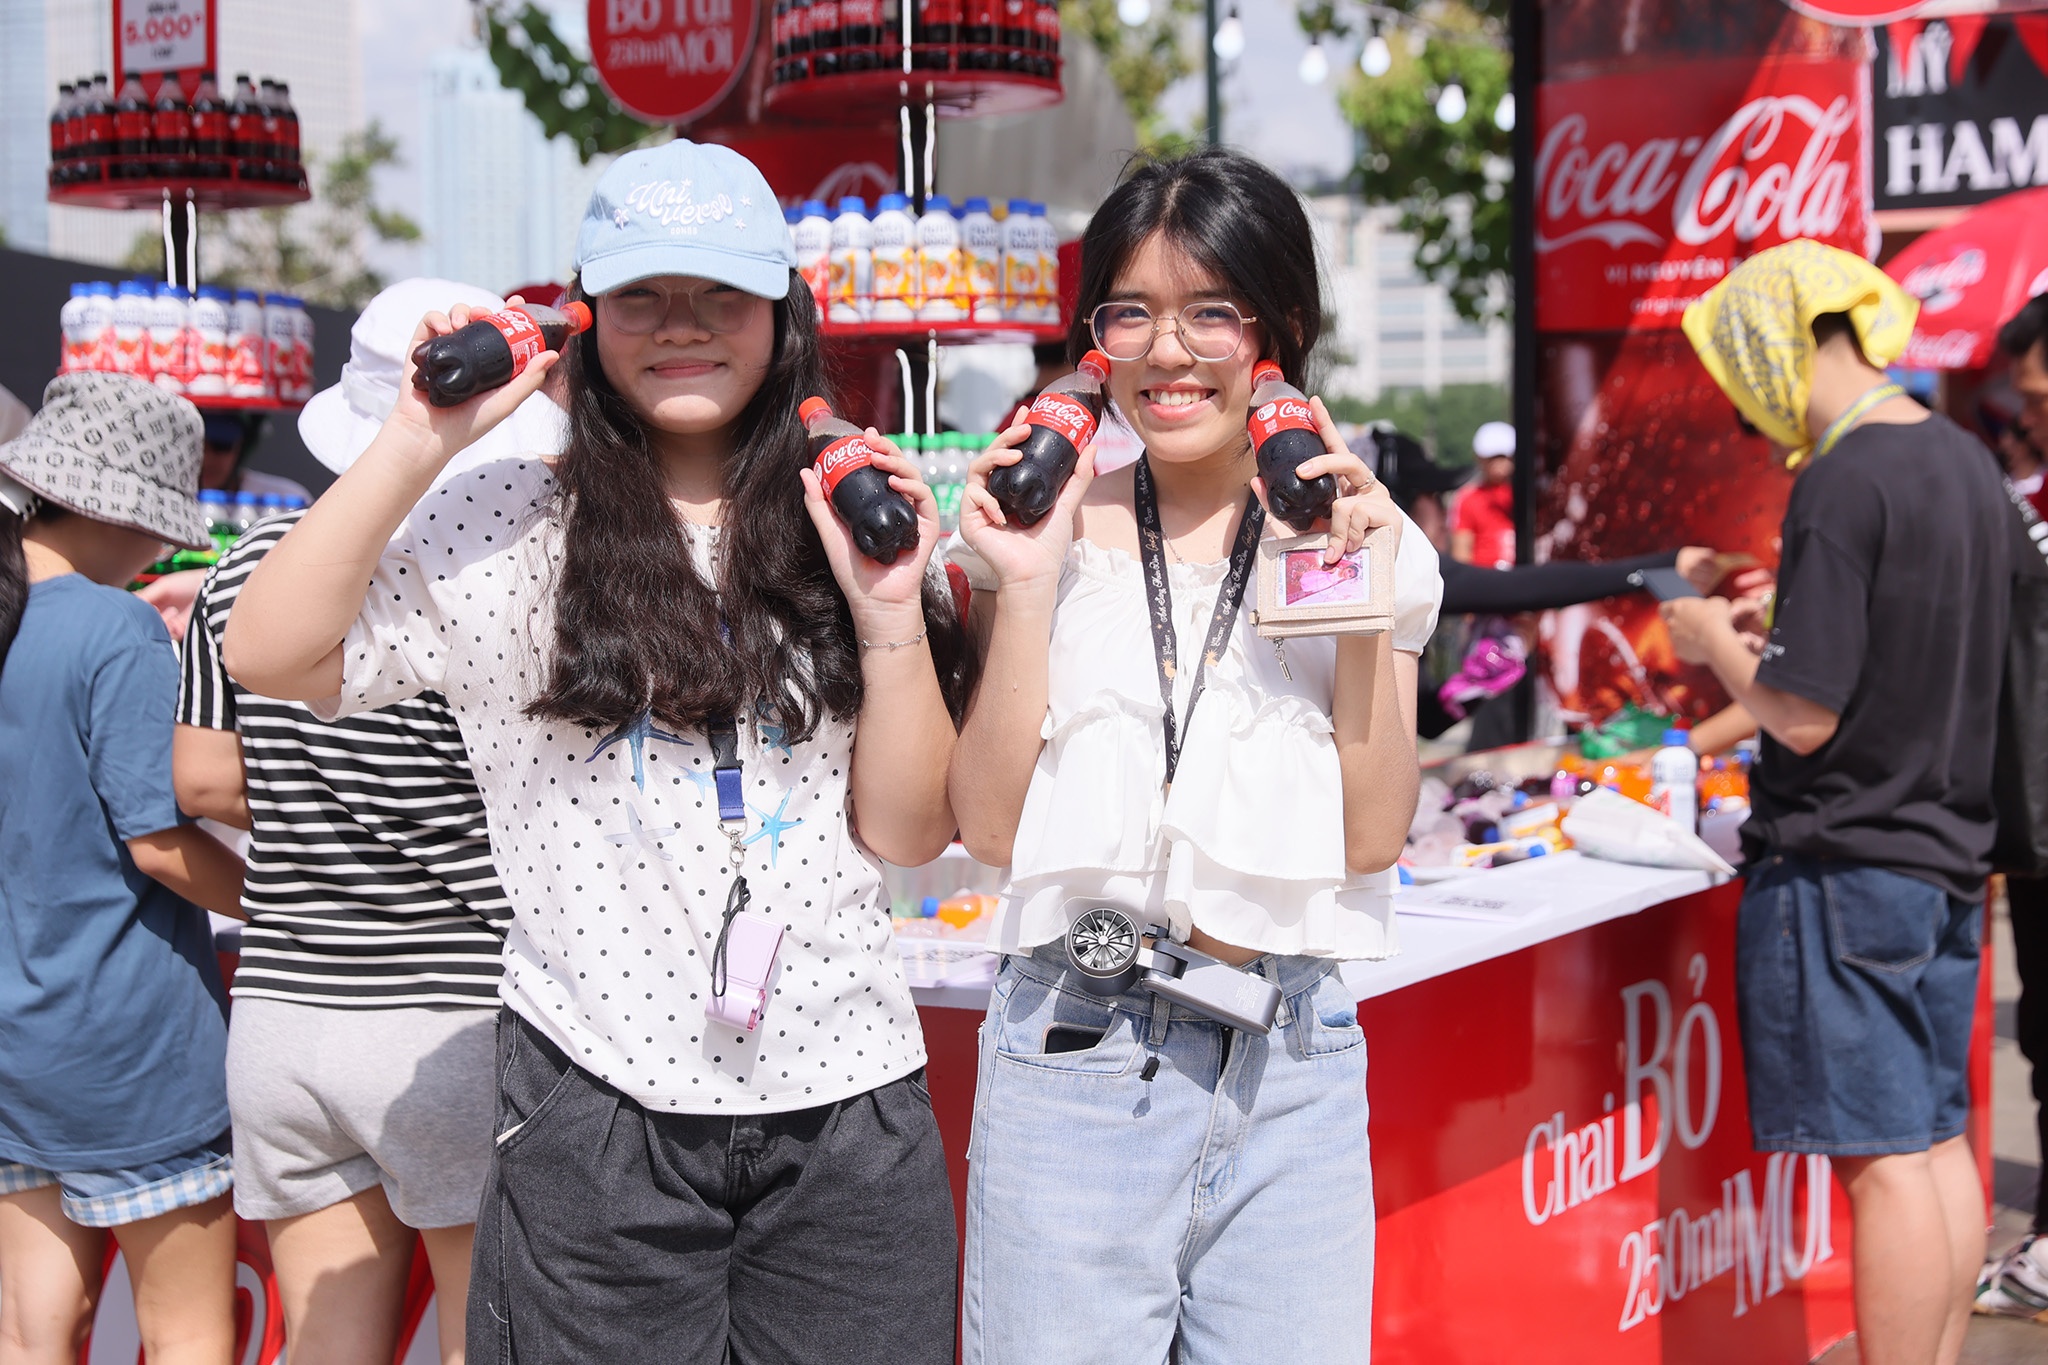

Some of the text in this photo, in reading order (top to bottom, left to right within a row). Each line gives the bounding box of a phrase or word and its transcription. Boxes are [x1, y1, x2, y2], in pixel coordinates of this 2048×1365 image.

[1030, 395, 1091, 430] Coca-Cola
[1521, 1093, 1616, 1226] Chai
[1618, 1178, 1735, 1333] 250ml
